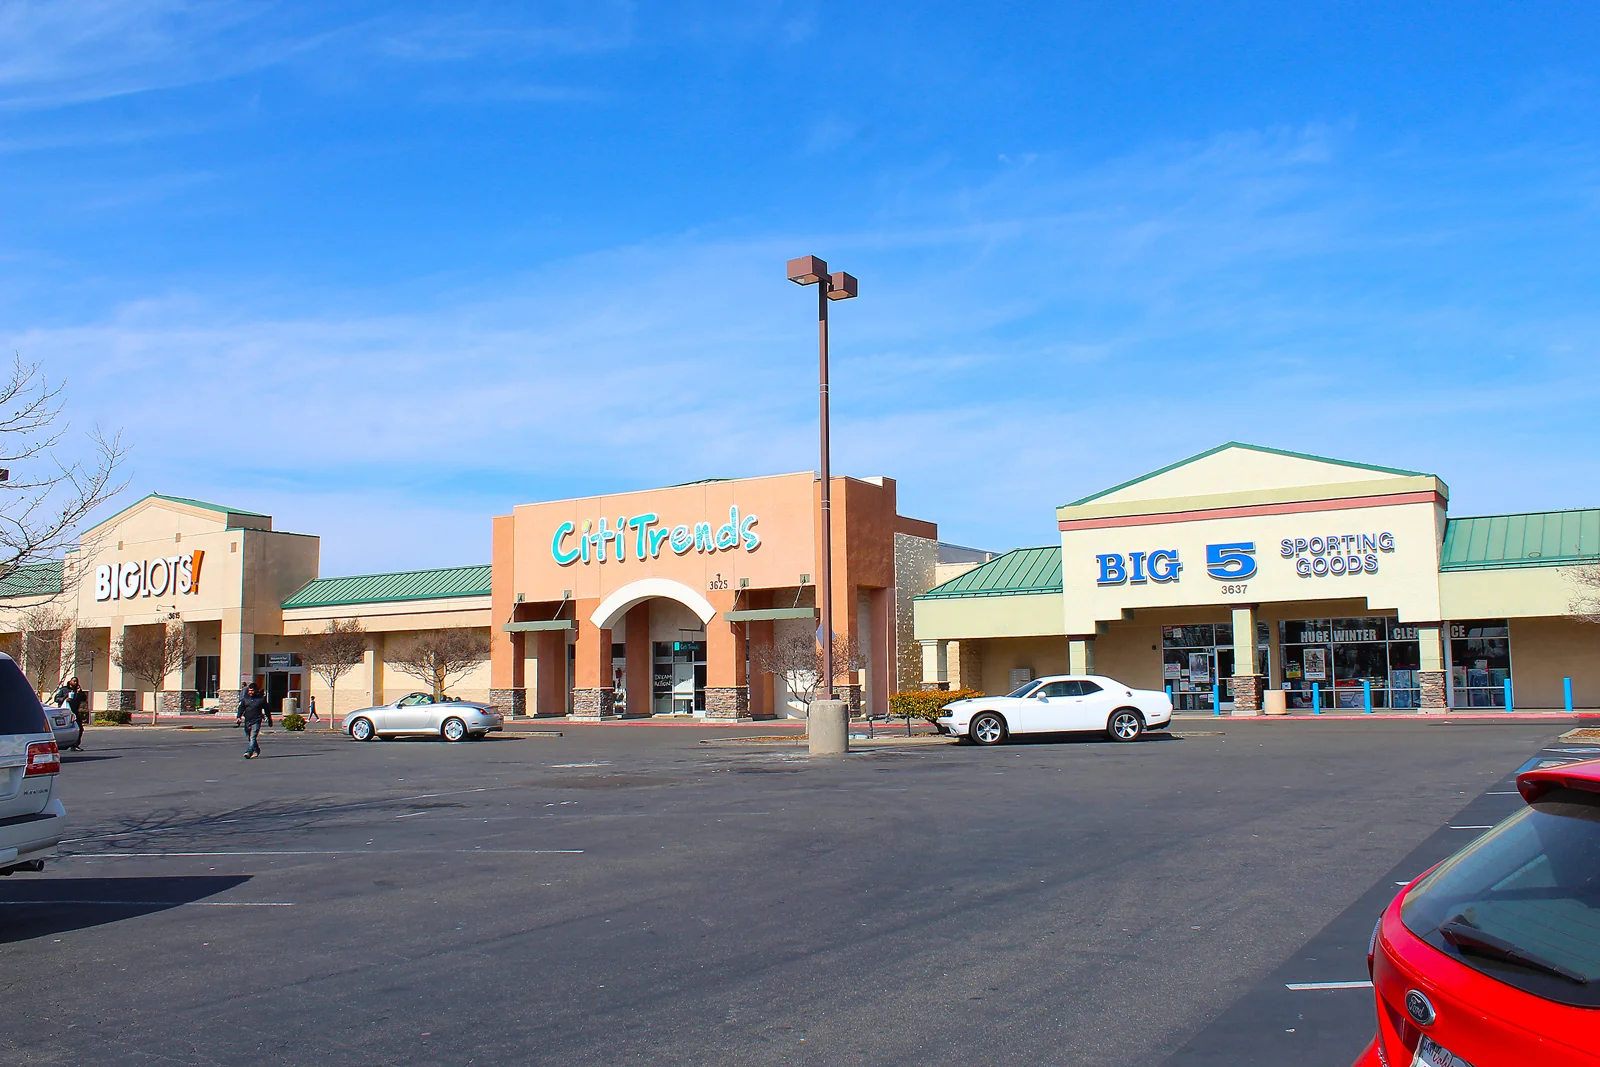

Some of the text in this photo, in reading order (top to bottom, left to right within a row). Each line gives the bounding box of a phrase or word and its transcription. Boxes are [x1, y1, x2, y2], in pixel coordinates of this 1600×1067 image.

[1280, 531, 1396, 557] SPORTING
[1096, 541, 1258, 586] BIG 5
[1296, 553, 1379, 577] GOODS
[709, 579, 728, 590] 3625
[1221, 584, 1248, 595] 3637
[1300, 630, 1330, 643] HUGE
[1333, 628, 1377, 642] WINTER
[1408, 995, 1425, 1018] Ford
